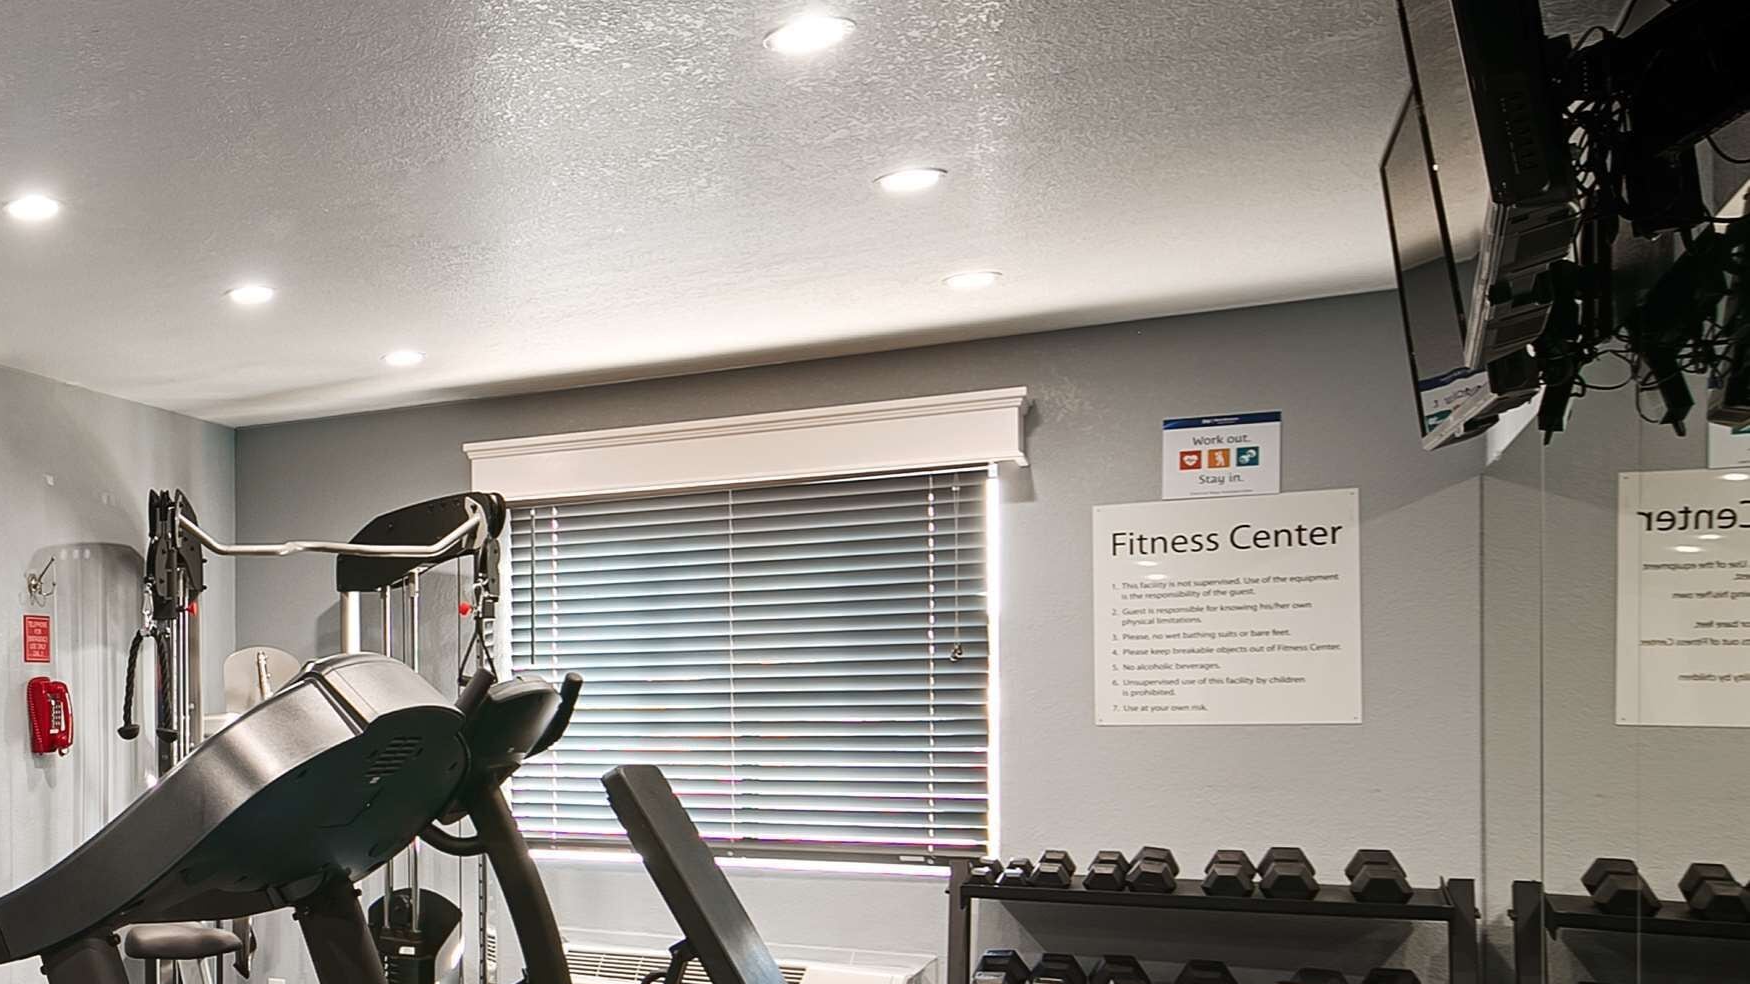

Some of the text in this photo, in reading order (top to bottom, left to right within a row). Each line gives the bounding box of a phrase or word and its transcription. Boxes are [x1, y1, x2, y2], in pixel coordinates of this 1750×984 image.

[1192, 433, 1252, 446] Work out.
[1198, 474, 1226, 485] Stay
[1112, 523, 1343, 556] Fitness Center
